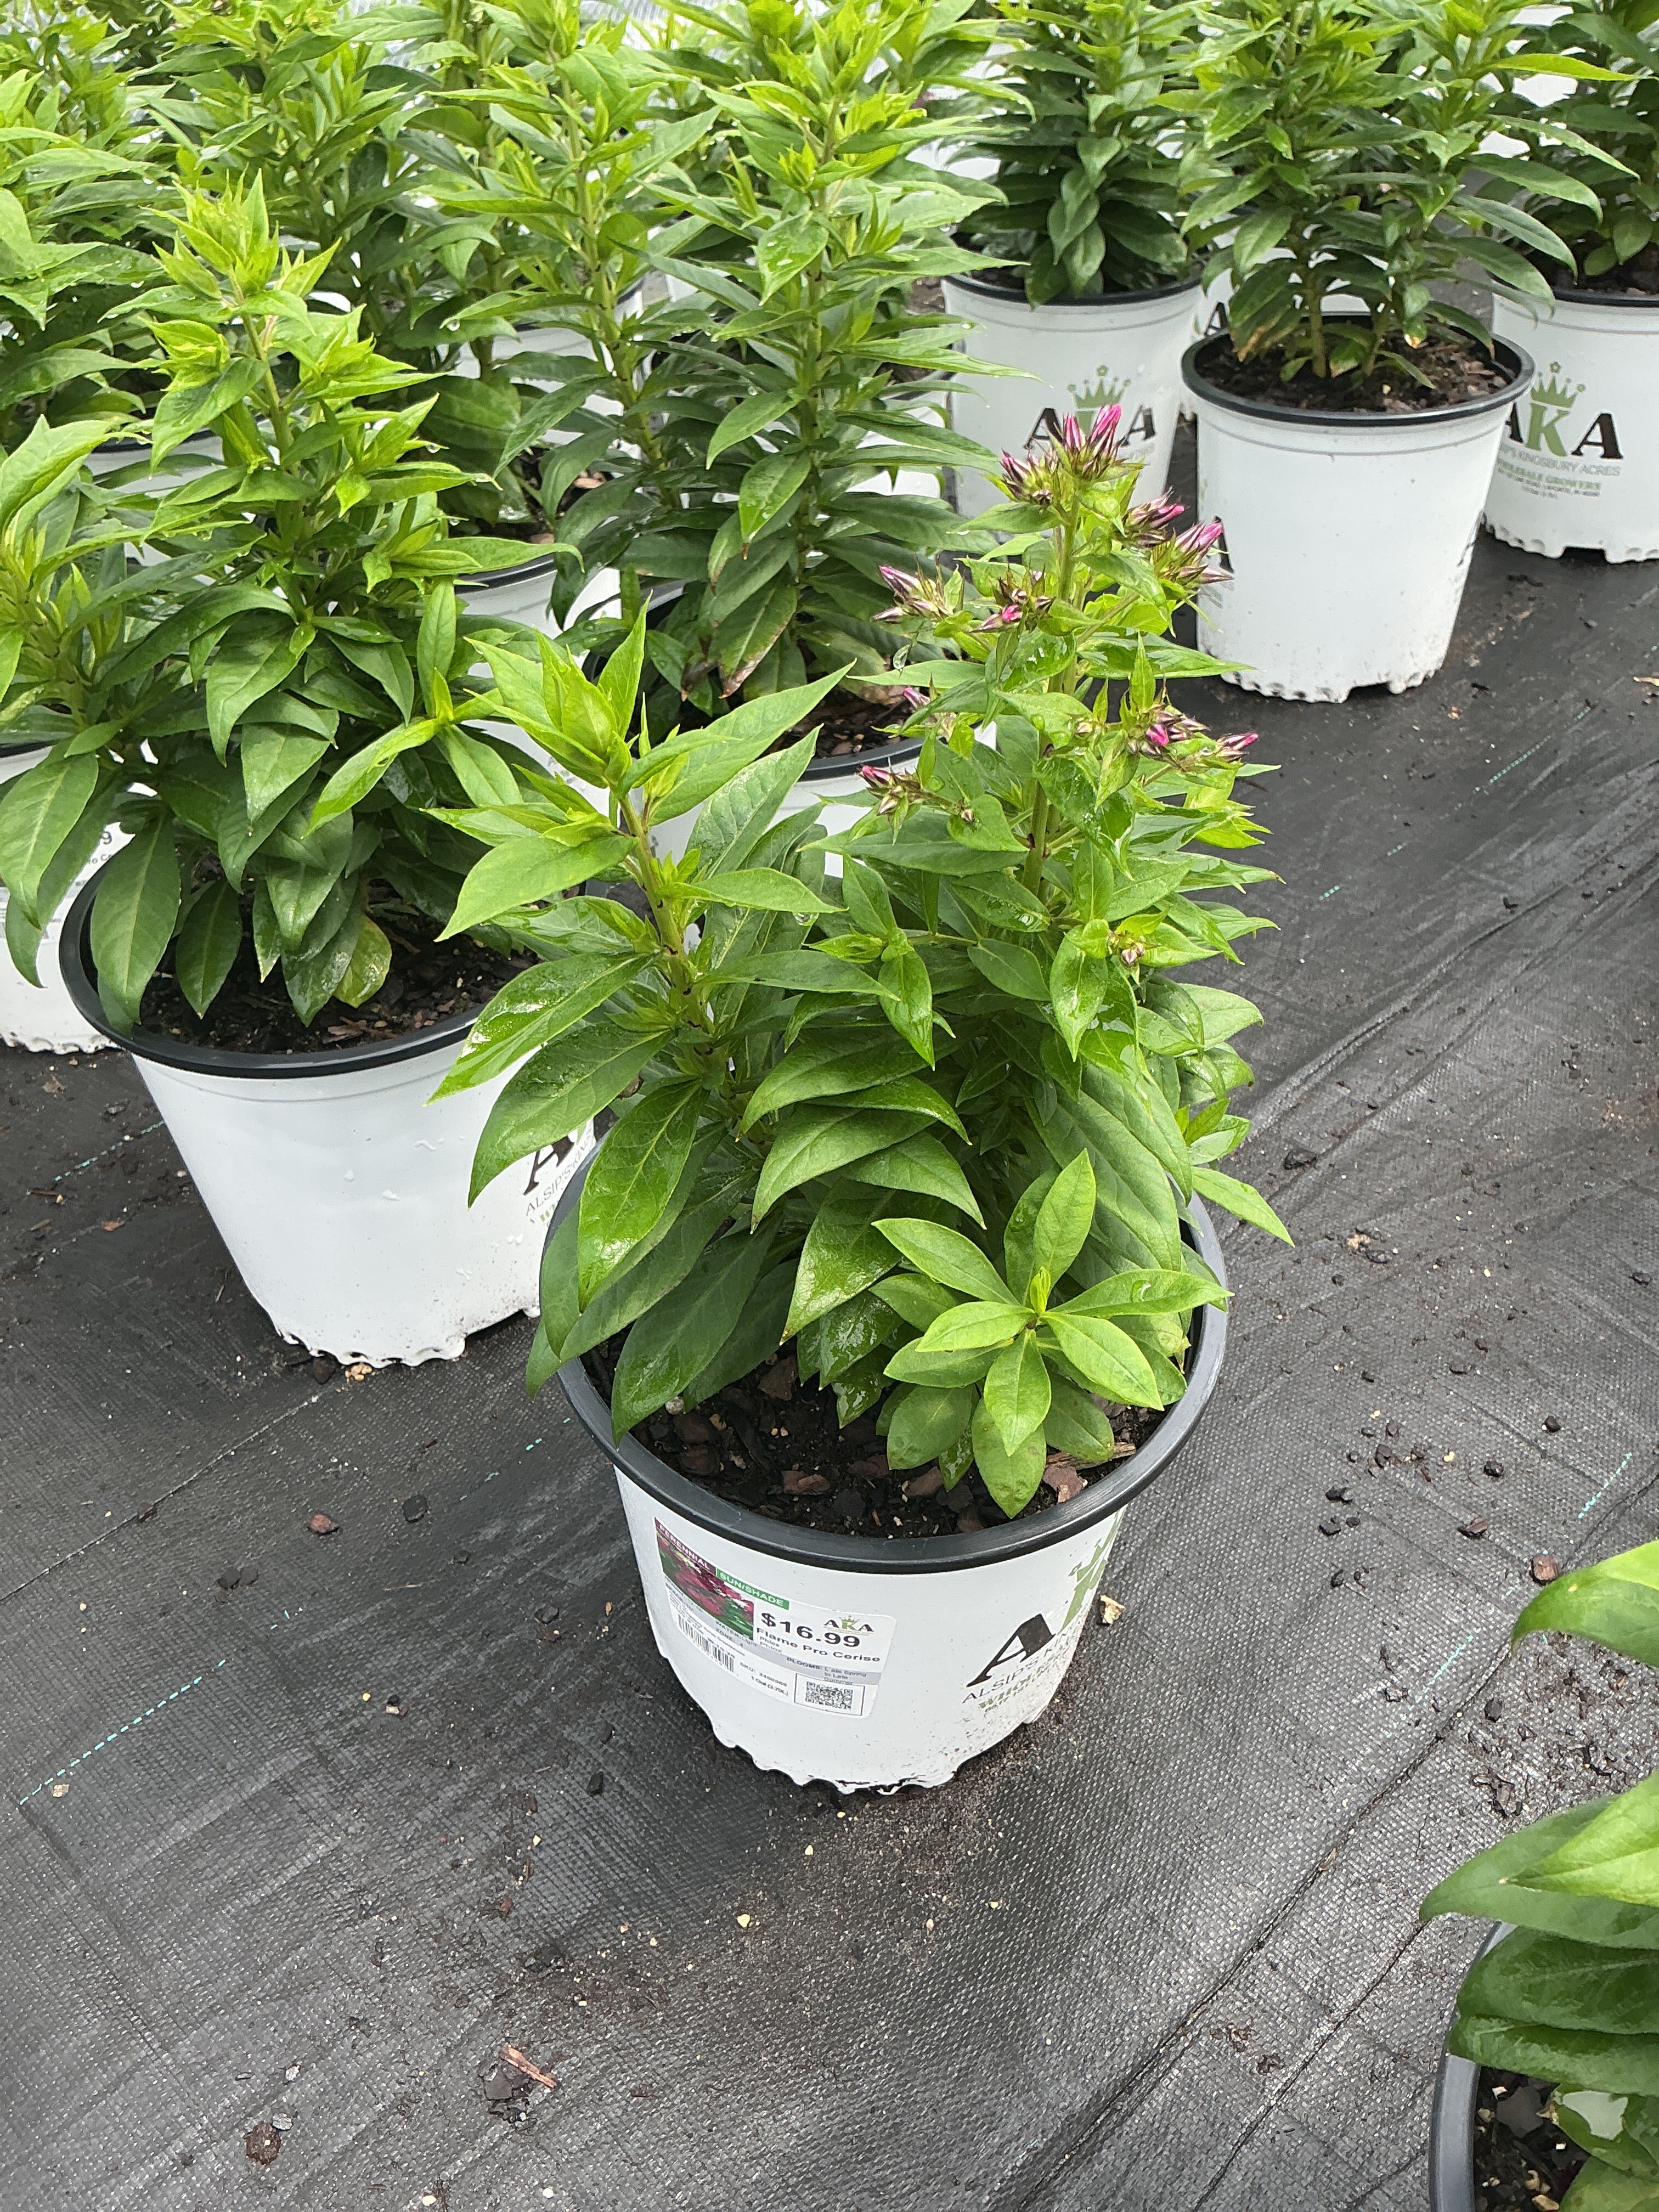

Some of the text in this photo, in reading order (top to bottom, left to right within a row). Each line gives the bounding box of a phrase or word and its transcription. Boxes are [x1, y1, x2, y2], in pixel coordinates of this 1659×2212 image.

[1023, 405, 1156, 449] AA
[526, 1165, 571, 1216] ALSIP'S
[659, 1523, 710, 1570] PERENNIAL
[720, 1572, 784, 1607] SUN/SHADE
[757, 1628, 798, 1648] Flame
[803, 1645, 828, 1656] Pro
[761, 1612, 860, 1647] $16.99
[823, 1618, 874, 1632] AKA
[962, 1656, 1039, 1704] ALSIP'S
